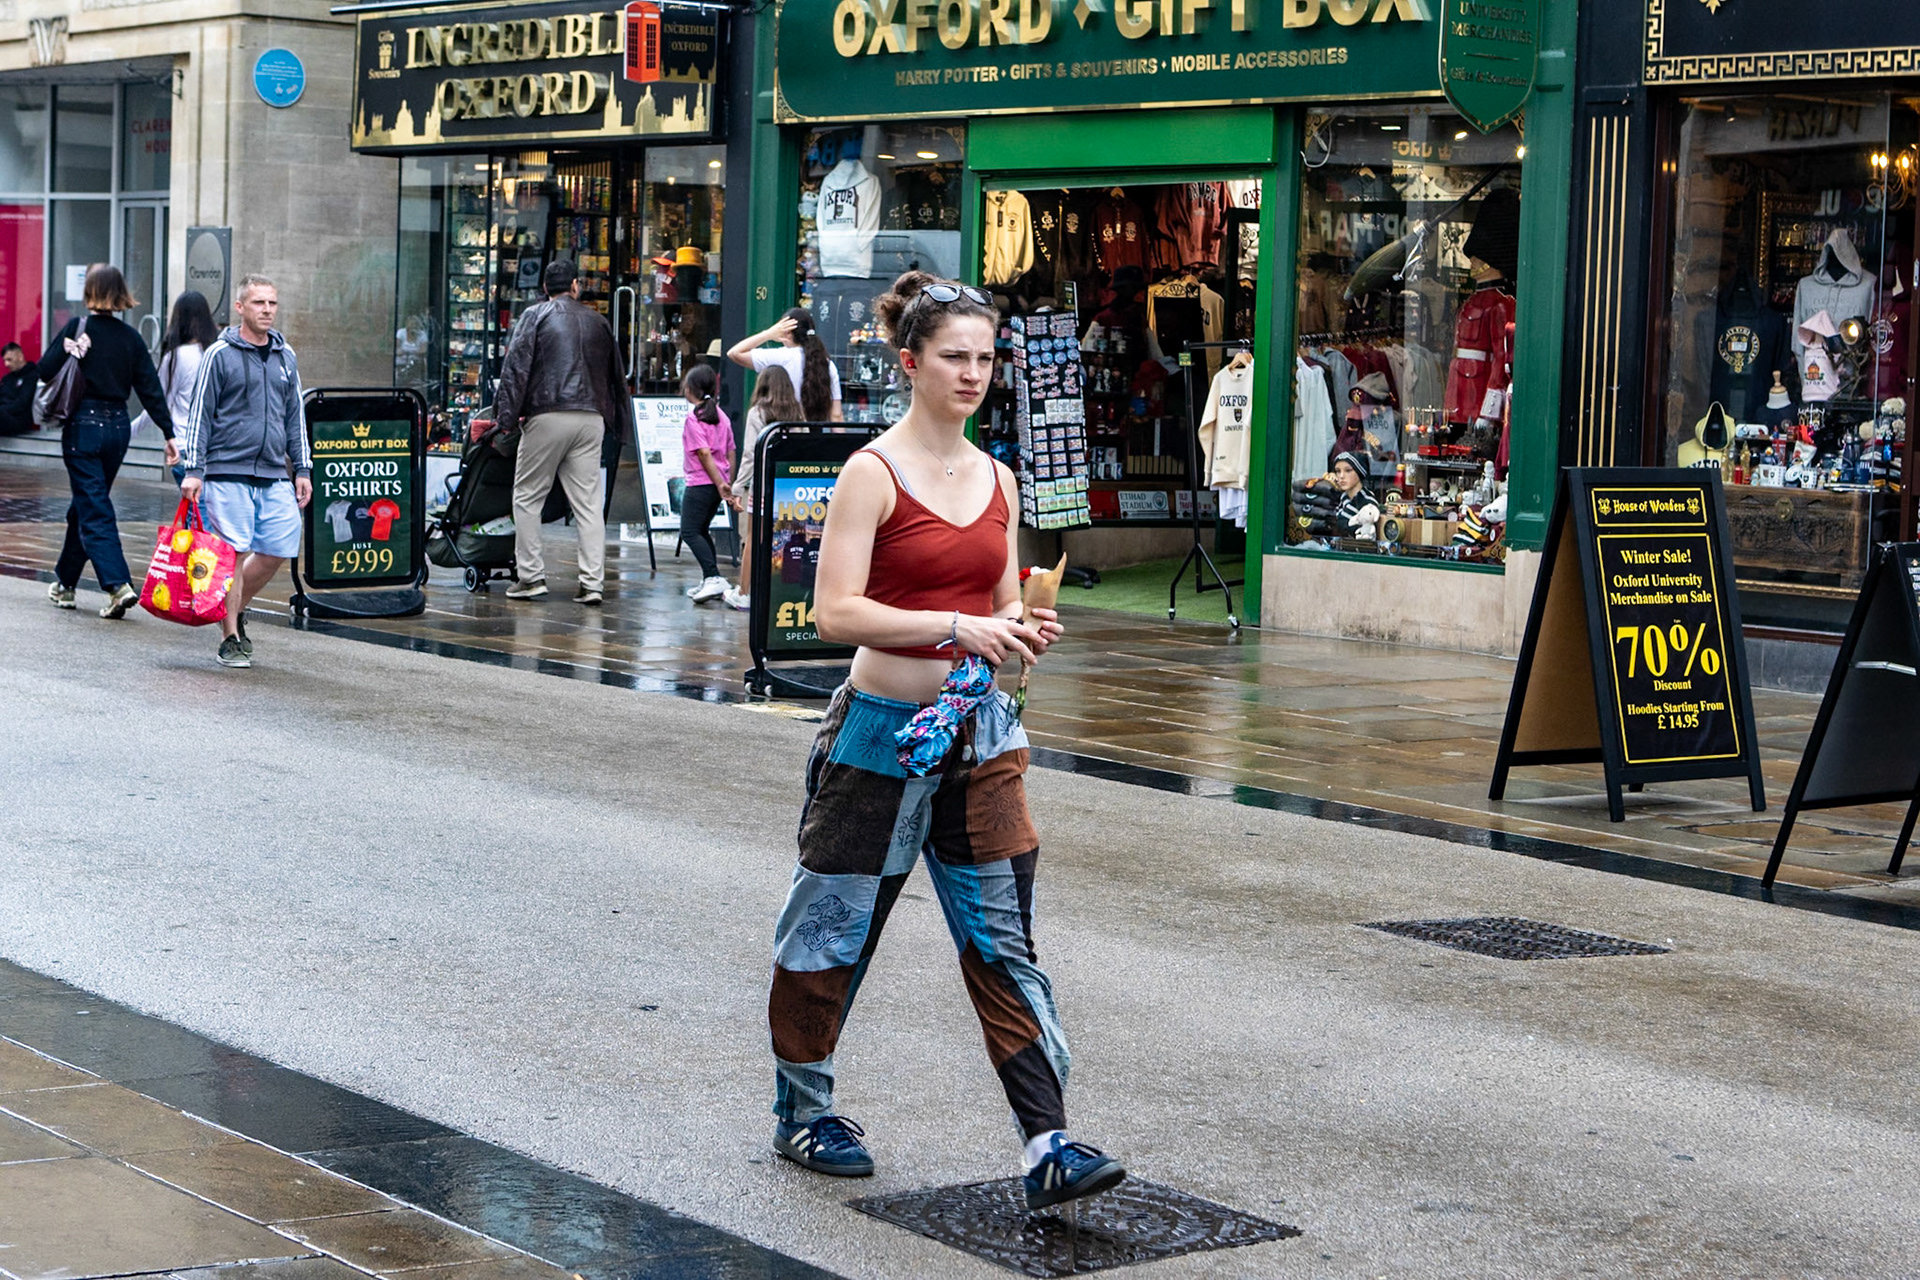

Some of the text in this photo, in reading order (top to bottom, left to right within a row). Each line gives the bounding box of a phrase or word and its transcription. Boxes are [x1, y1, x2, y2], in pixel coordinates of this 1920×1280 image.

[1459, 2, 1527, 22] UNIVERSITY
[664, 23, 716, 36] INCREDIBLE
[833, 0, 1053, 57] OXFORD
[1451, 21, 1533, 44] MERCHANDISE
[671, 41, 708, 52] OXFORD
[896, 47, 1348, 86] HARRY POTTER GIFTS & SOUVENIRS MOBILE ACCESSORIES
[437, 70, 602, 121] OXFORD
[131, 118, 172, 133] CLAREN
[145, 139, 171, 153] HOU
[189, 266, 222, 280] Clarendon
[756, 286, 768, 300] 50
[314, 439, 408, 450] OXFORD GIFT BOX
[325, 461, 399, 477] OXFORD
[789, 466, 821, 474] OXFORD
[321, 480, 403, 497] T-SHIRTS
[794, 487, 834, 501] OXFO
[778, 501, 828, 521] HOO
[1121, 501, 1153, 510] STADIUM
[1612, 498, 1685, 514] House of Wonders
[352, 543, 372, 551] JUST
[331, 548, 394, 574] £9.99
[1620, 549, 1692, 564] Winter Sale!
[1613, 573, 1702, 588] Oxford University
[1610, 590, 1713, 605] Merchandise on Sale
[776, 602, 817, 628] £14
[786, 632, 821, 641] SPECIA
[1616, 623, 1720, 678] 70%
[1653, 680, 1692, 691] Discount
[1627, 700, 1725, 715] Hoodies Starting From
[1657, 714, 1700, 729] £ 14.95
